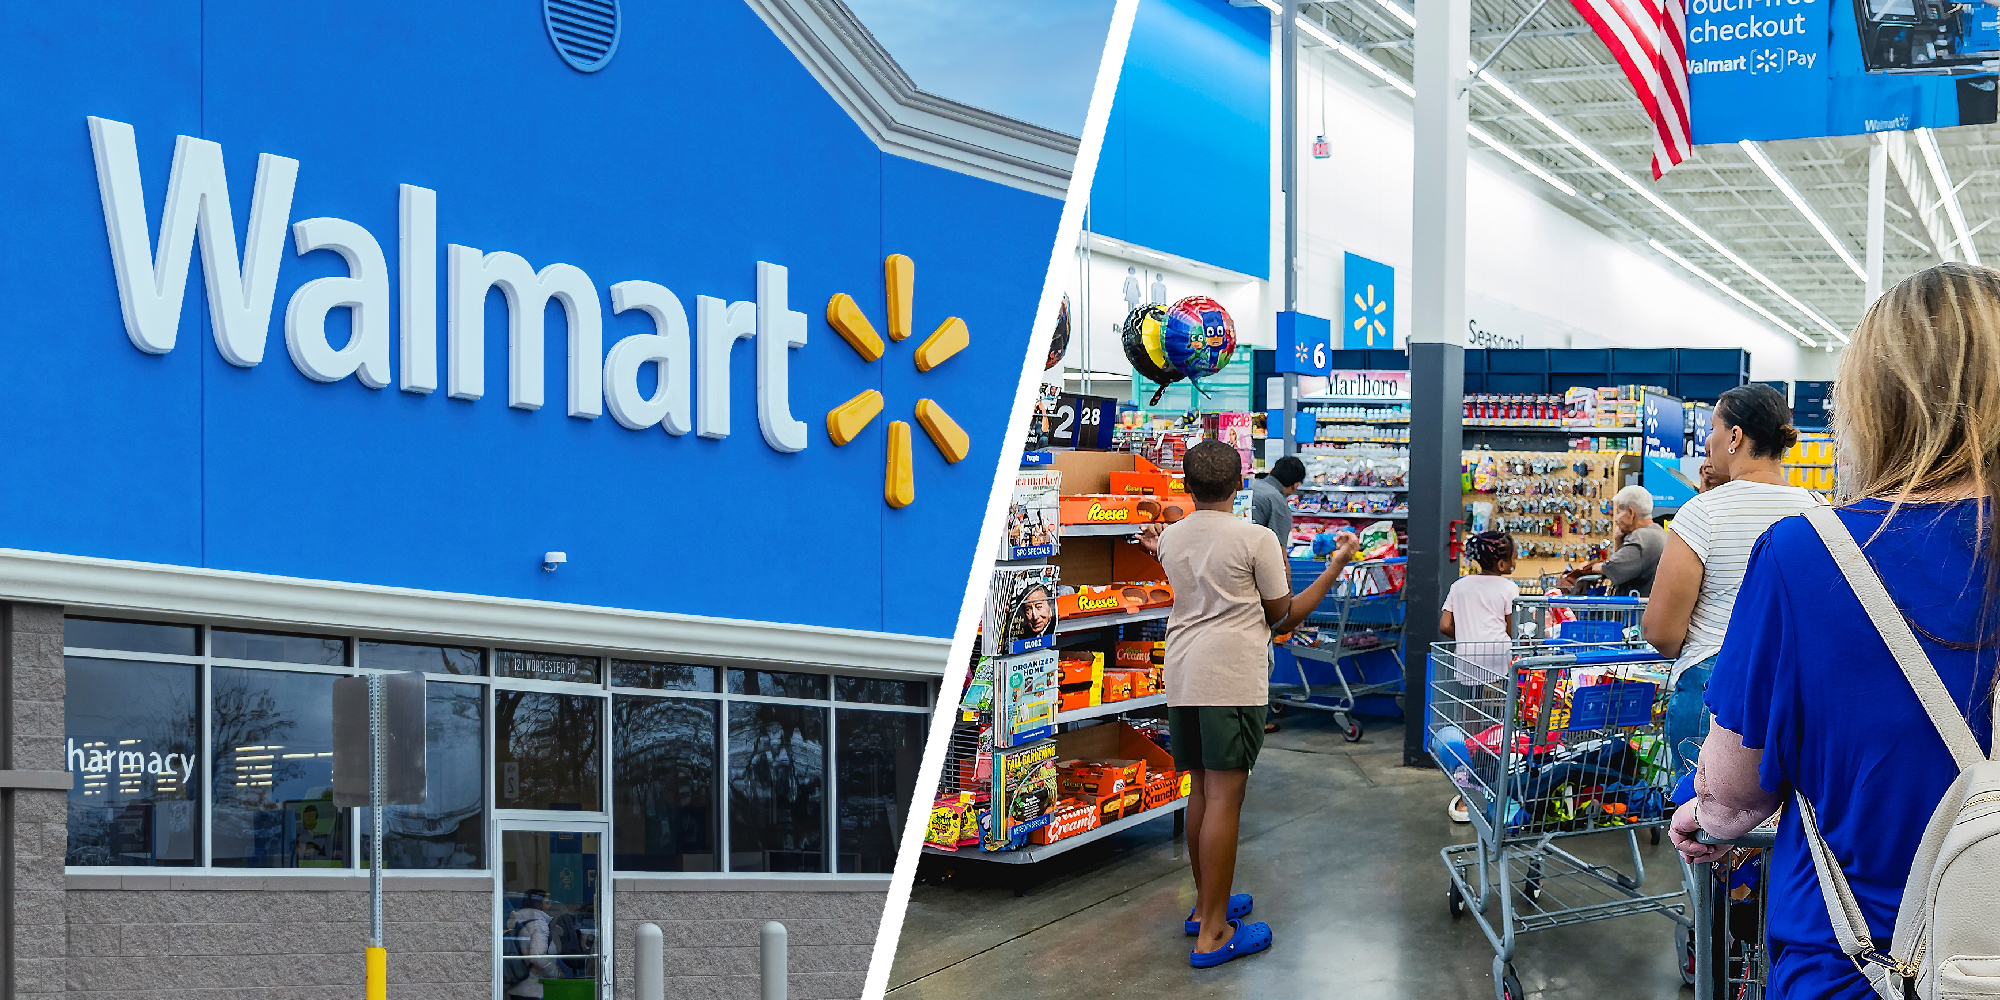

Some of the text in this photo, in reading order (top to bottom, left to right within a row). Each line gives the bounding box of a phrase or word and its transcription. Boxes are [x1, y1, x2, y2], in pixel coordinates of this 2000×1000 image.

[1690, 13, 1806, 43] checkout
[1787, 49, 1817, 68] Pay
[1865, 117, 1900, 132] Walmart
[88, 115, 807, 453] Walmart
[1313, 342, 1326, 369] 6
[1325, 373, 1398, 397] Marlboro
[1053, 405, 1075, 439] 2
[1081, 407, 1101, 426] 28
[1087, 503, 1129, 521] Reese's
[1078, 595, 1118, 611] Reese's
[1012, 657, 1054, 672] ORGANIZED
[1116, 648, 1151, 664] Creamy
[514, 658, 576, 675] 121 WORCESTER RD
[1023, 666, 1045, 676] HOME
[64, 737, 196, 783] harmacy
[1006, 756, 1022, 771] FALL
[1022, 746, 1056, 765] GARDENING
[1048, 814, 1097, 844] Creamy
